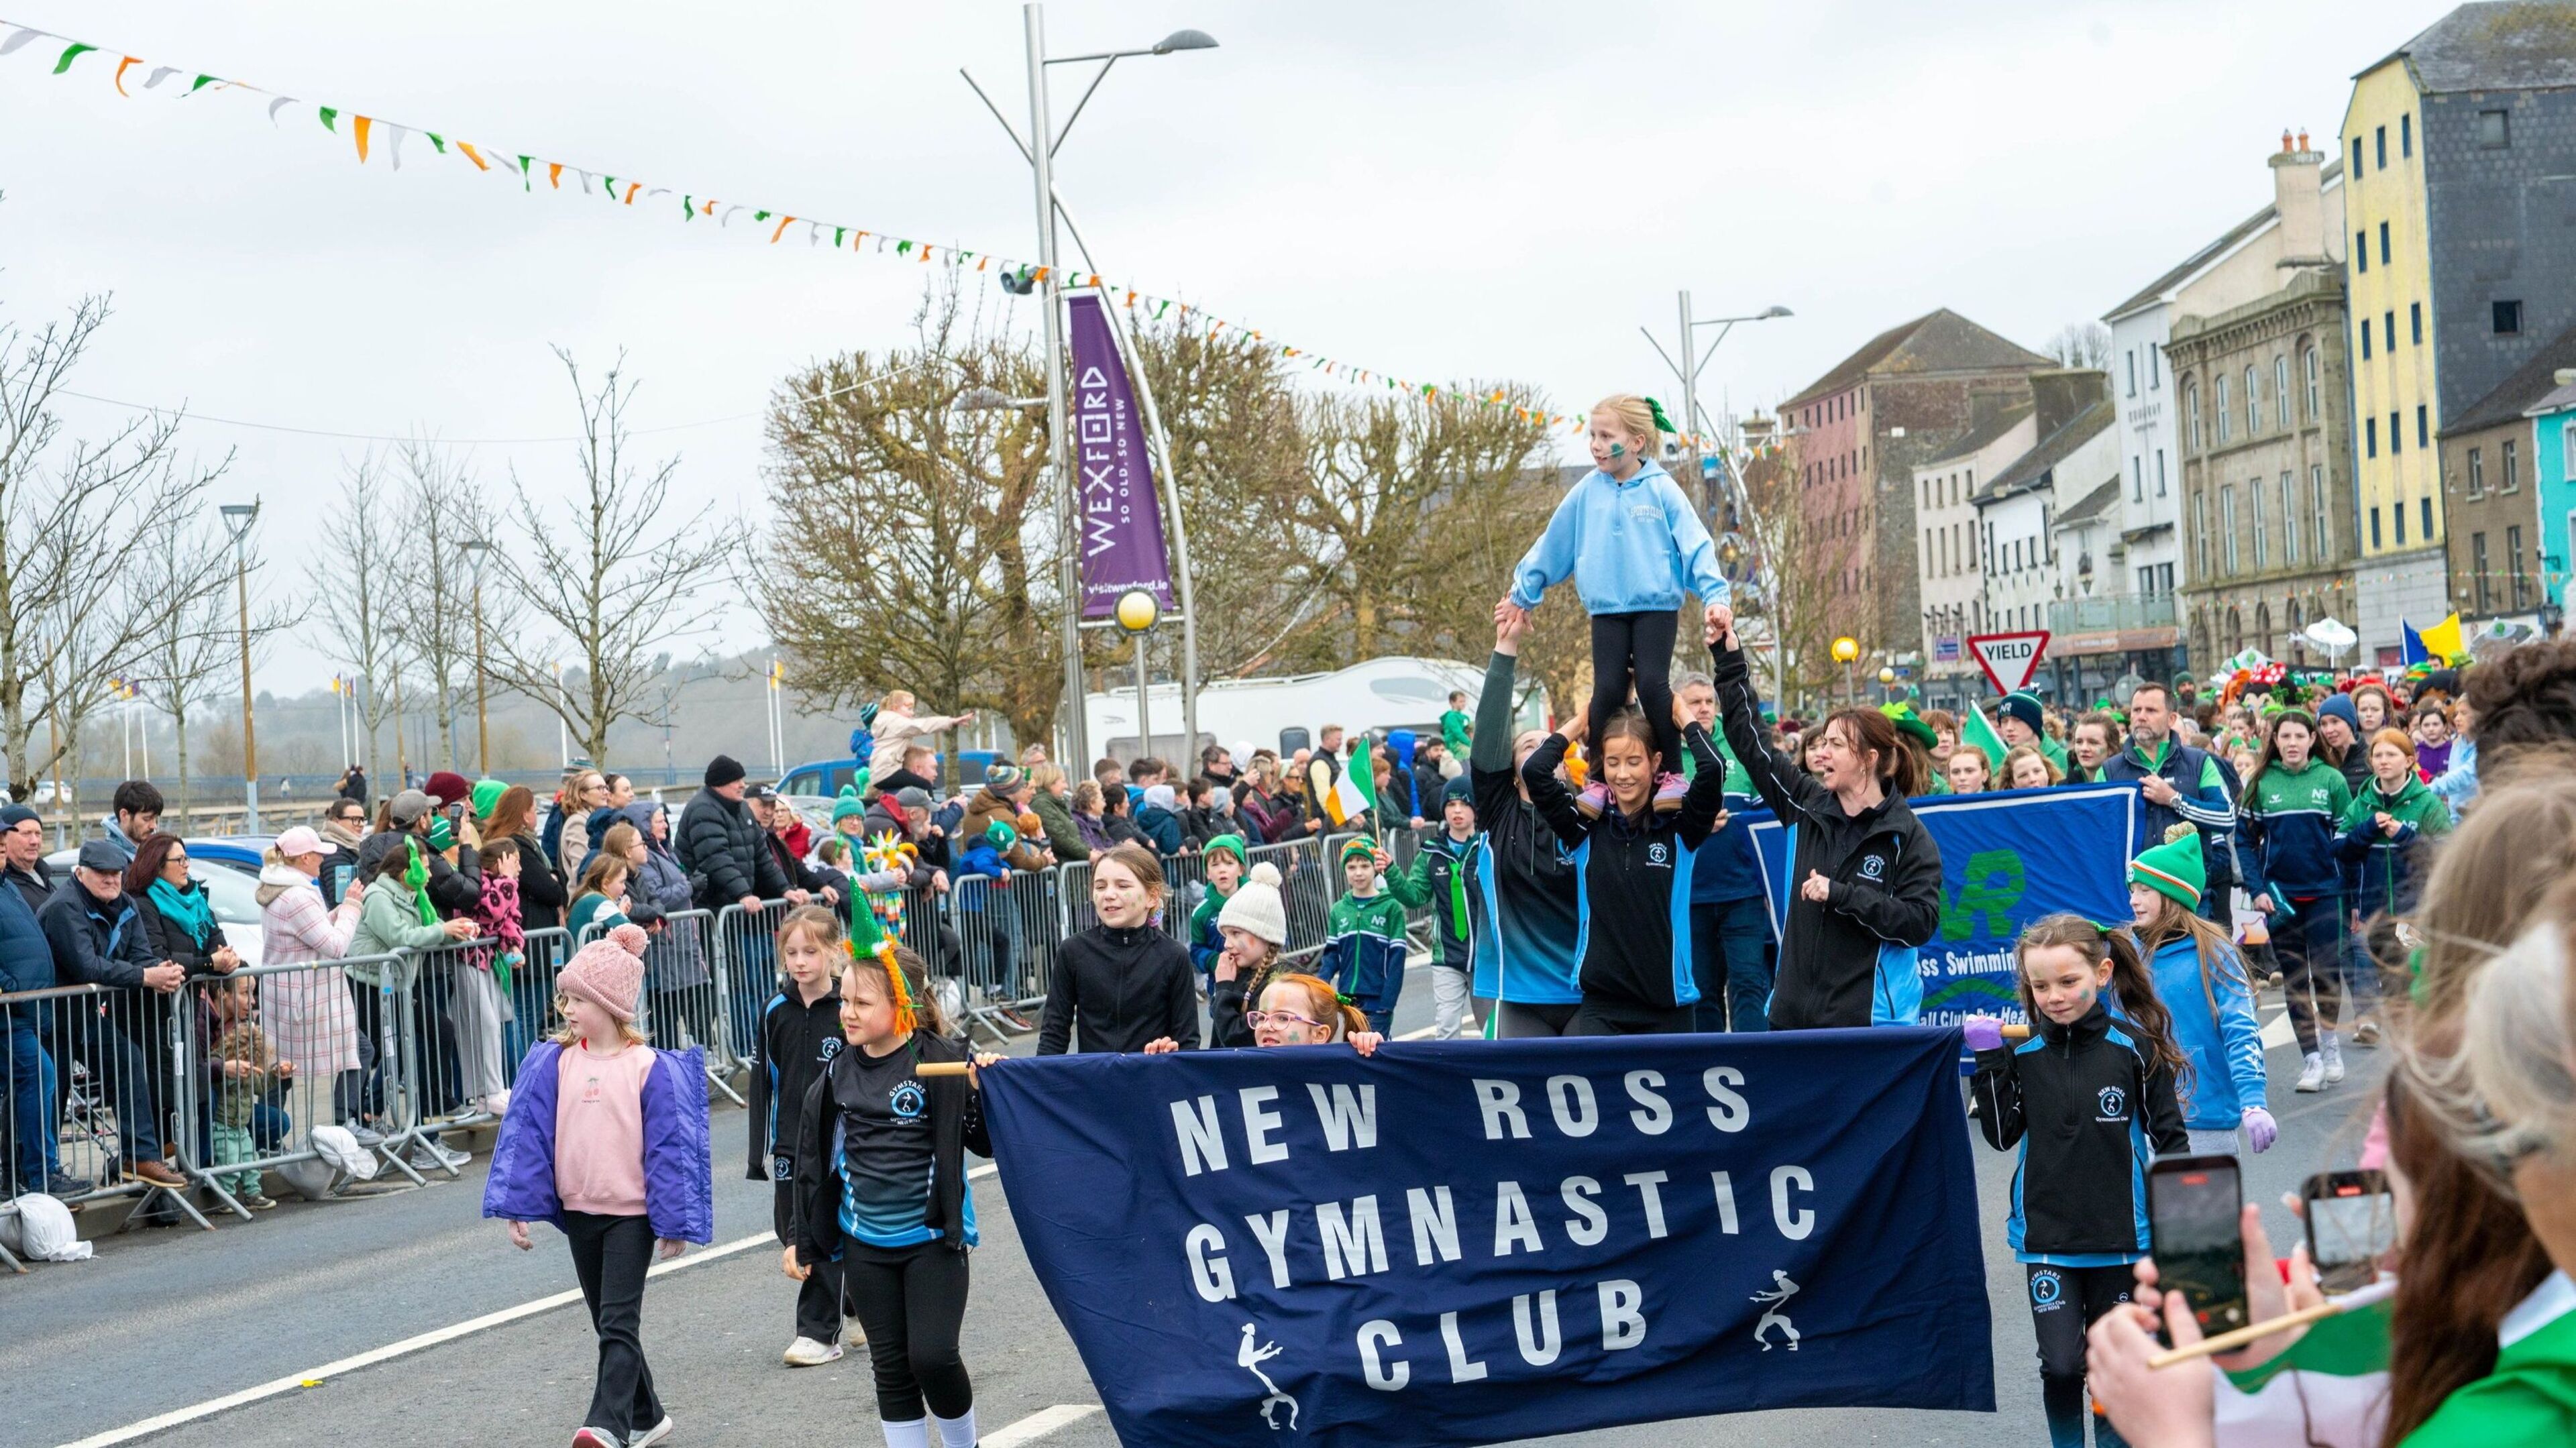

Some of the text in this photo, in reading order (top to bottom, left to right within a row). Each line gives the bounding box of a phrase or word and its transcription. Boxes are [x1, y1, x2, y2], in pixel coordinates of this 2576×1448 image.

[1115, 398, 1126, 430] NEW
[1117, 438, 1128, 457] SO
[1080, 366, 1116, 557] WEXFORD
[1120, 504, 1130, 523] SO
[1986, 643, 2032, 661] YIELD
[2312, 788, 2329, 800] NR
[1371, 914, 1387, 927] NR
[889, 1080, 926, 1097] GYMSTARS
[2098, 1086, 2126, 1098] NEW ROSS
[1169, 1066, 1751, 1176] NEW ROSS
[1185, 1164, 1815, 1302] GYMNASTIC
[2030, 1270, 2061, 1286] GYMSTARS
[1356, 1278, 1647, 1391] CLUB
